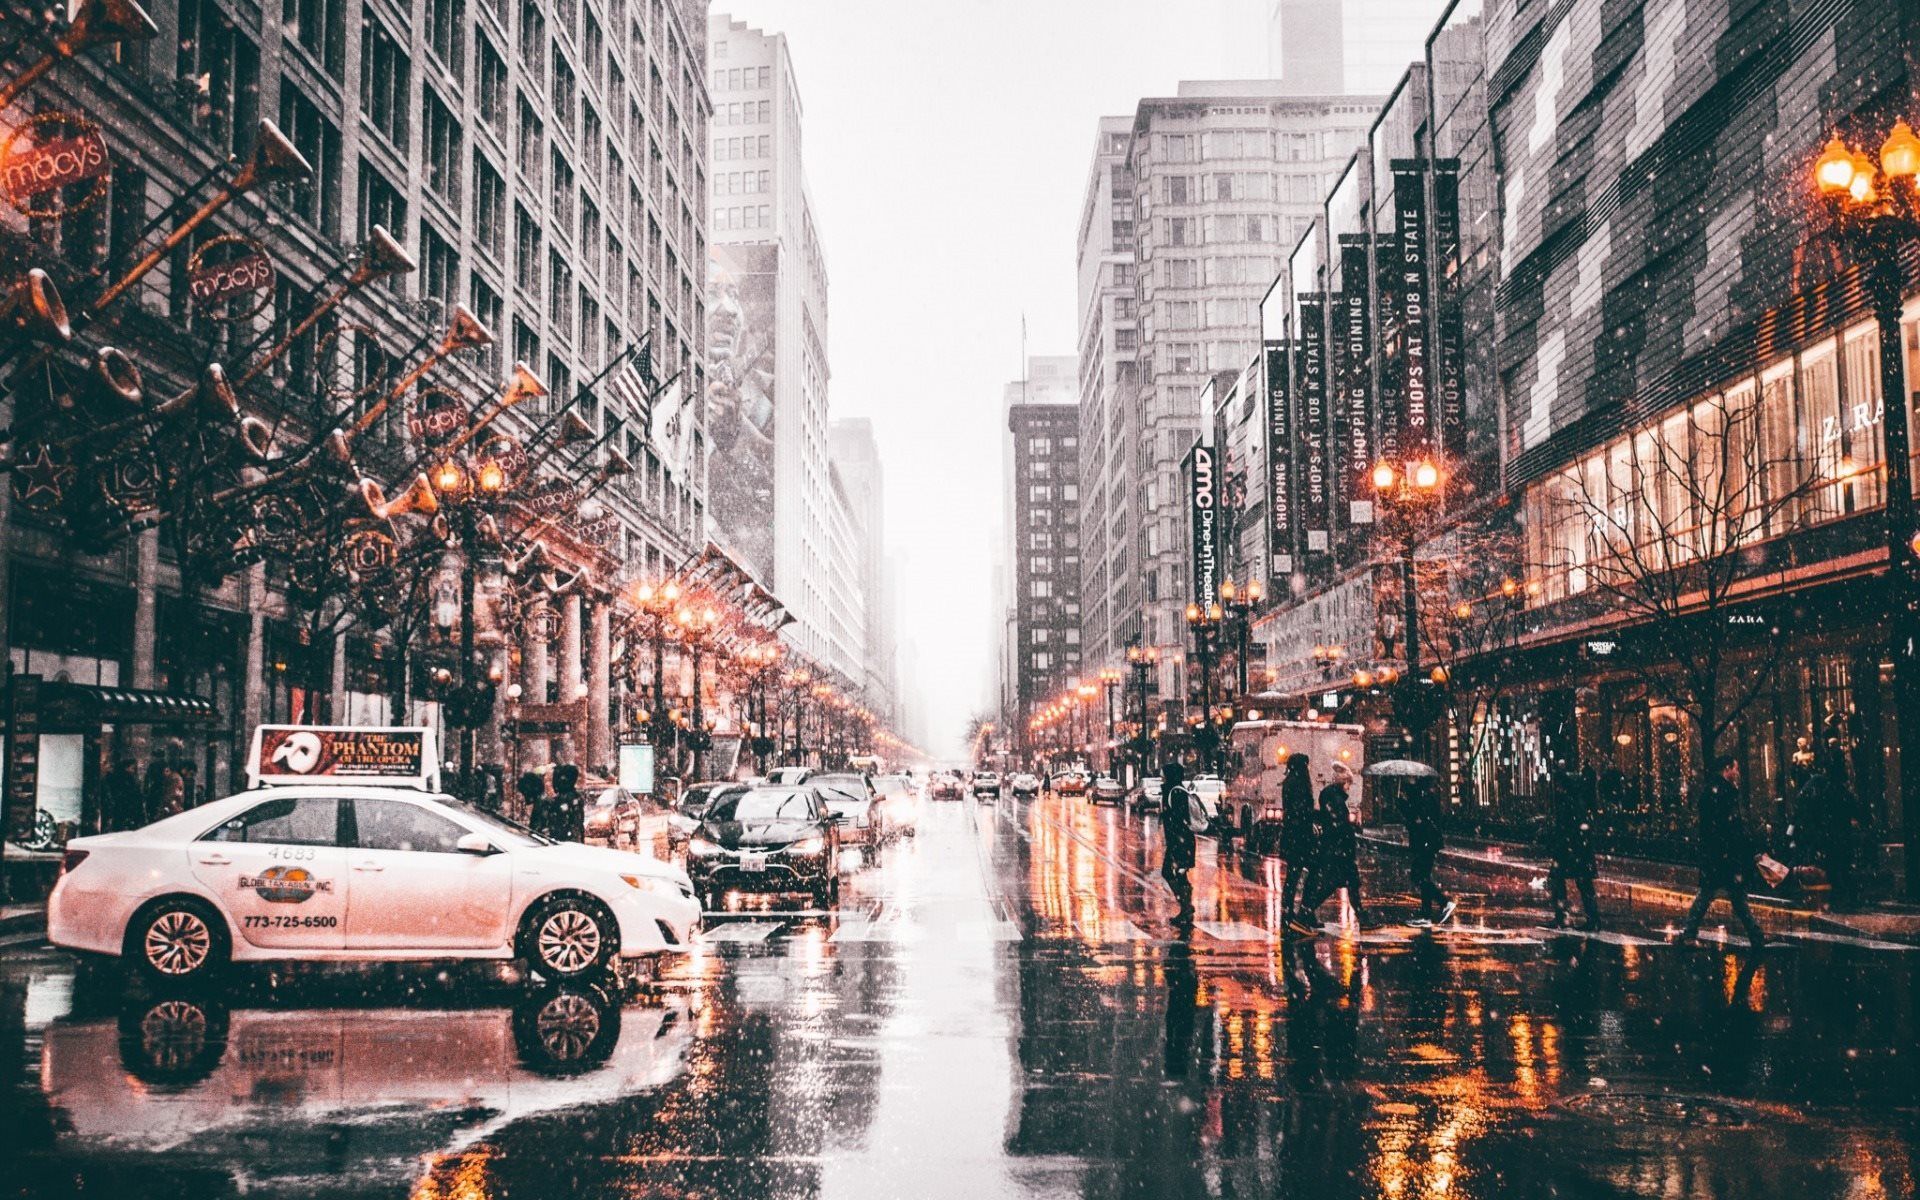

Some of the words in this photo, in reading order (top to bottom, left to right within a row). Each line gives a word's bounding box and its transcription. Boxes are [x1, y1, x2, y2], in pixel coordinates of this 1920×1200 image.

[1403, 209, 1420, 263] STATE
[1406, 272, 1420, 283] N
[1407, 293, 1421, 324] 108
[1350, 297, 1363, 353] DINING
[1306, 330, 1319, 376] STATE
[1408, 337, 1422, 357] AT
[1308, 381, 1319, 390] N
[1410, 366, 1425, 427] SHOPS
[1273, 390, 1284, 435] DINING
[1308, 397, 1320, 424] 108
[1309, 432, 1321, 448] AT
[1352, 388, 1367, 471] SHOPPING
[1195, 448, 1213, 508] amc
[1310, 455, 1322, 503] SHOPS
[1275, 463, 1287, 530] SHOPPING
[1728, 615, 1765, 624] ZARA
[333, 741, 420, 756] PHANTOM
[366, 734, 388, 743] THE
[357, 755, 374, 763] THE
[377, 756, 411, 764] OPERA
[268, 847, 316, 861] 4683
[244, 916, 338, 928] 773-725-6500
